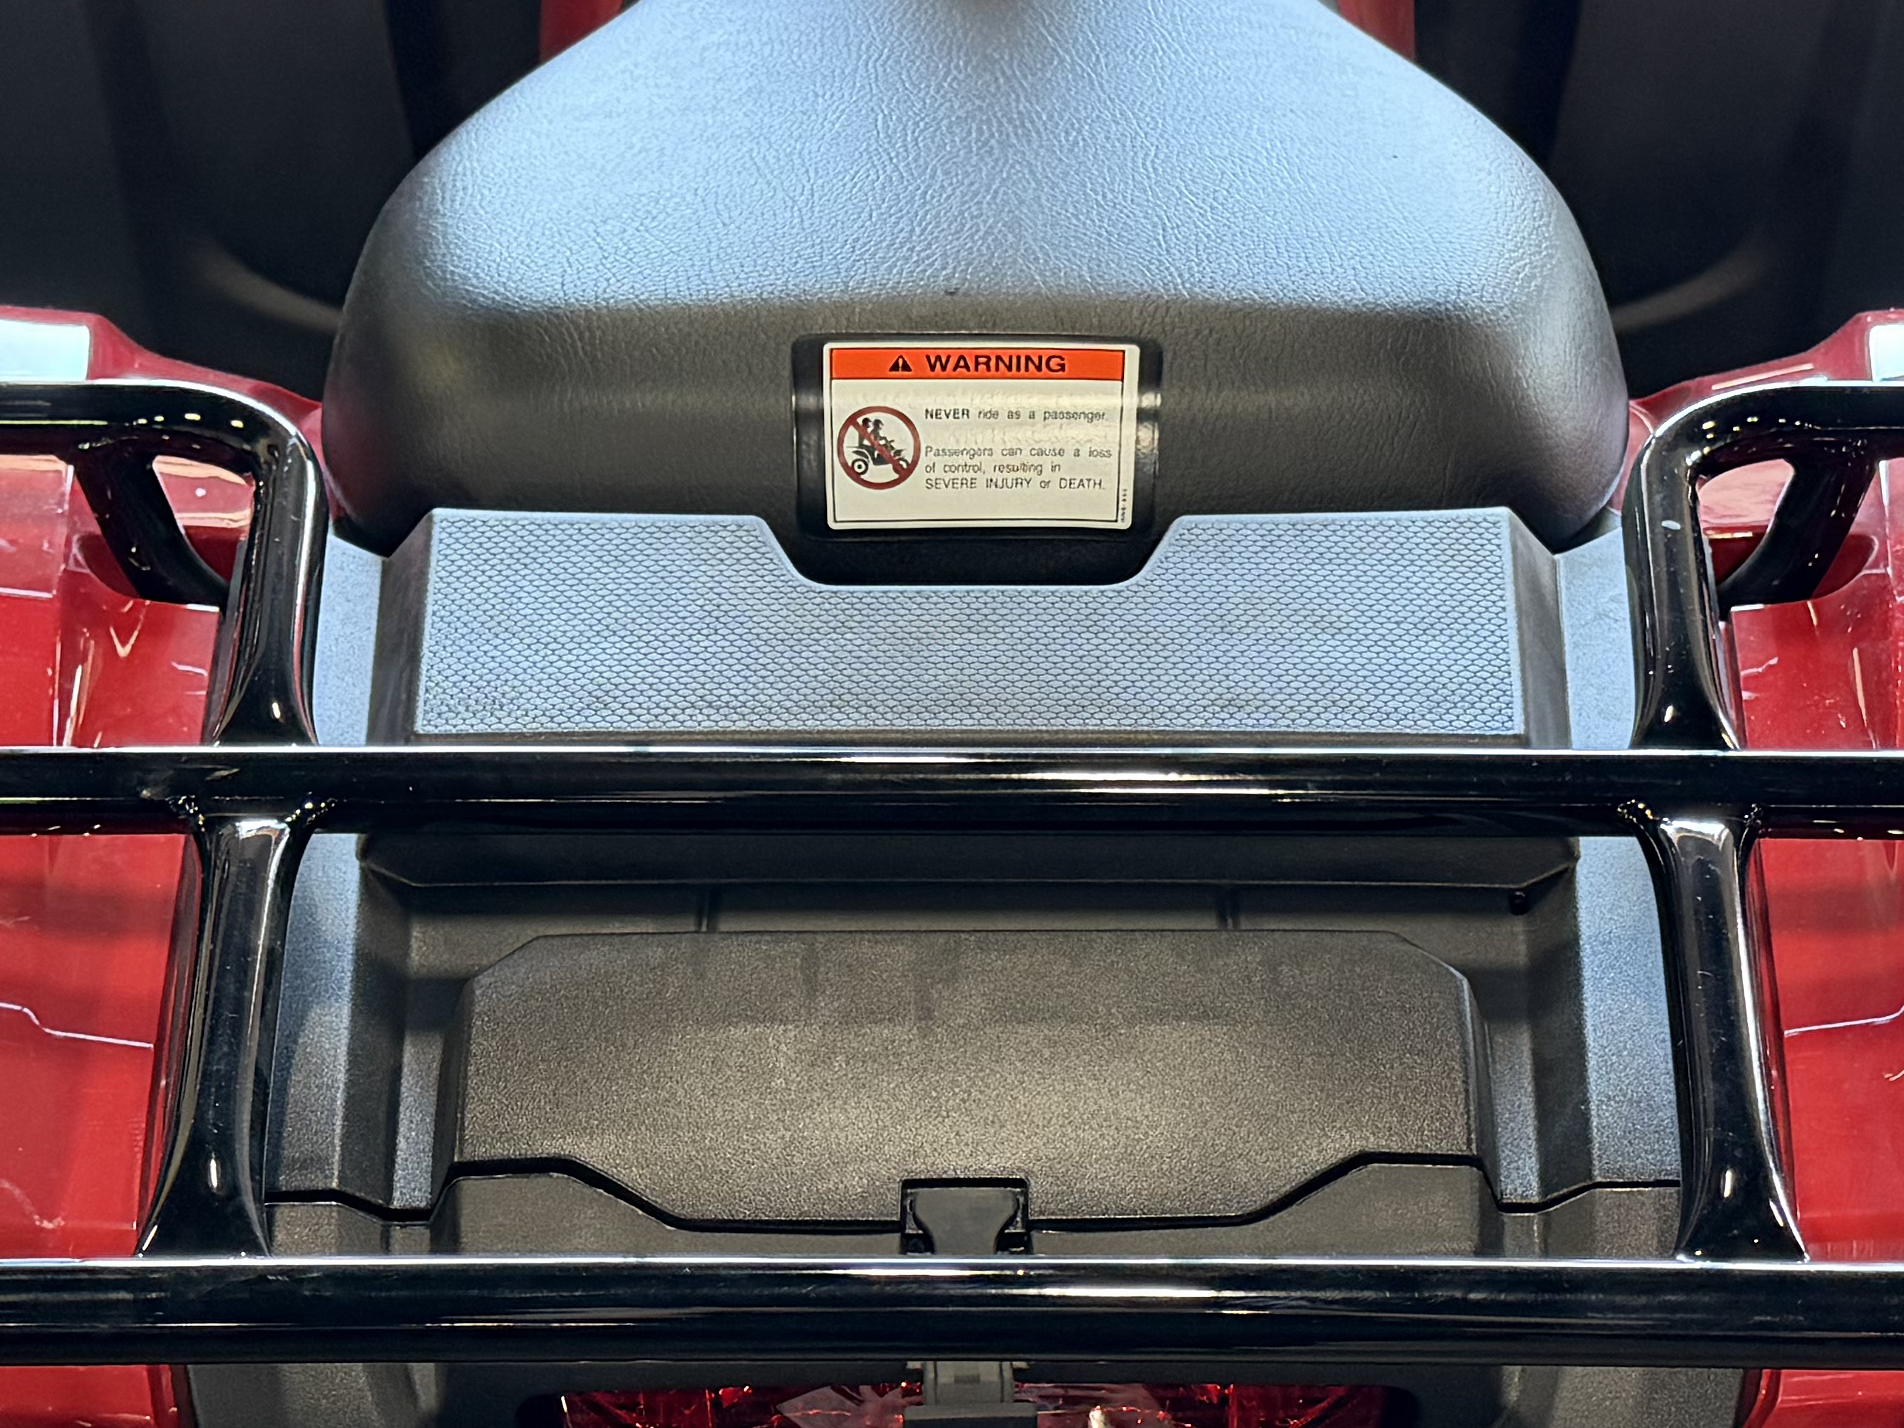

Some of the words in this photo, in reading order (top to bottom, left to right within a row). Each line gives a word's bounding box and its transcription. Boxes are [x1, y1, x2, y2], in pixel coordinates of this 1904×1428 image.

[925, 354, 1066, 373] WARNING
[924, 408, 970, 420] NEVER
[977, 408, 999, 420] ride
[1007, 410, 1021, 420] as
[1028, 410, 1036, 420] a
[924, 446, 994, 460] Passengers
[1001, 448, 1022, 458] can
[1029, 448, 1065, 458] cause
[1073, 448, 1080, 458] a
[1088, 446, 1113, 458] loss
[924, 462, 936, 474] of
[993, 462, 1043, 477] resulting
[1050, 463, 1061, 473] in
[924, 477, 977, 490] SEVERE
[985, 477, 1033, 490] INJURY
[1039, 480, 1052, 490] or
[1059, 477, 1106, 491] DEATH.
